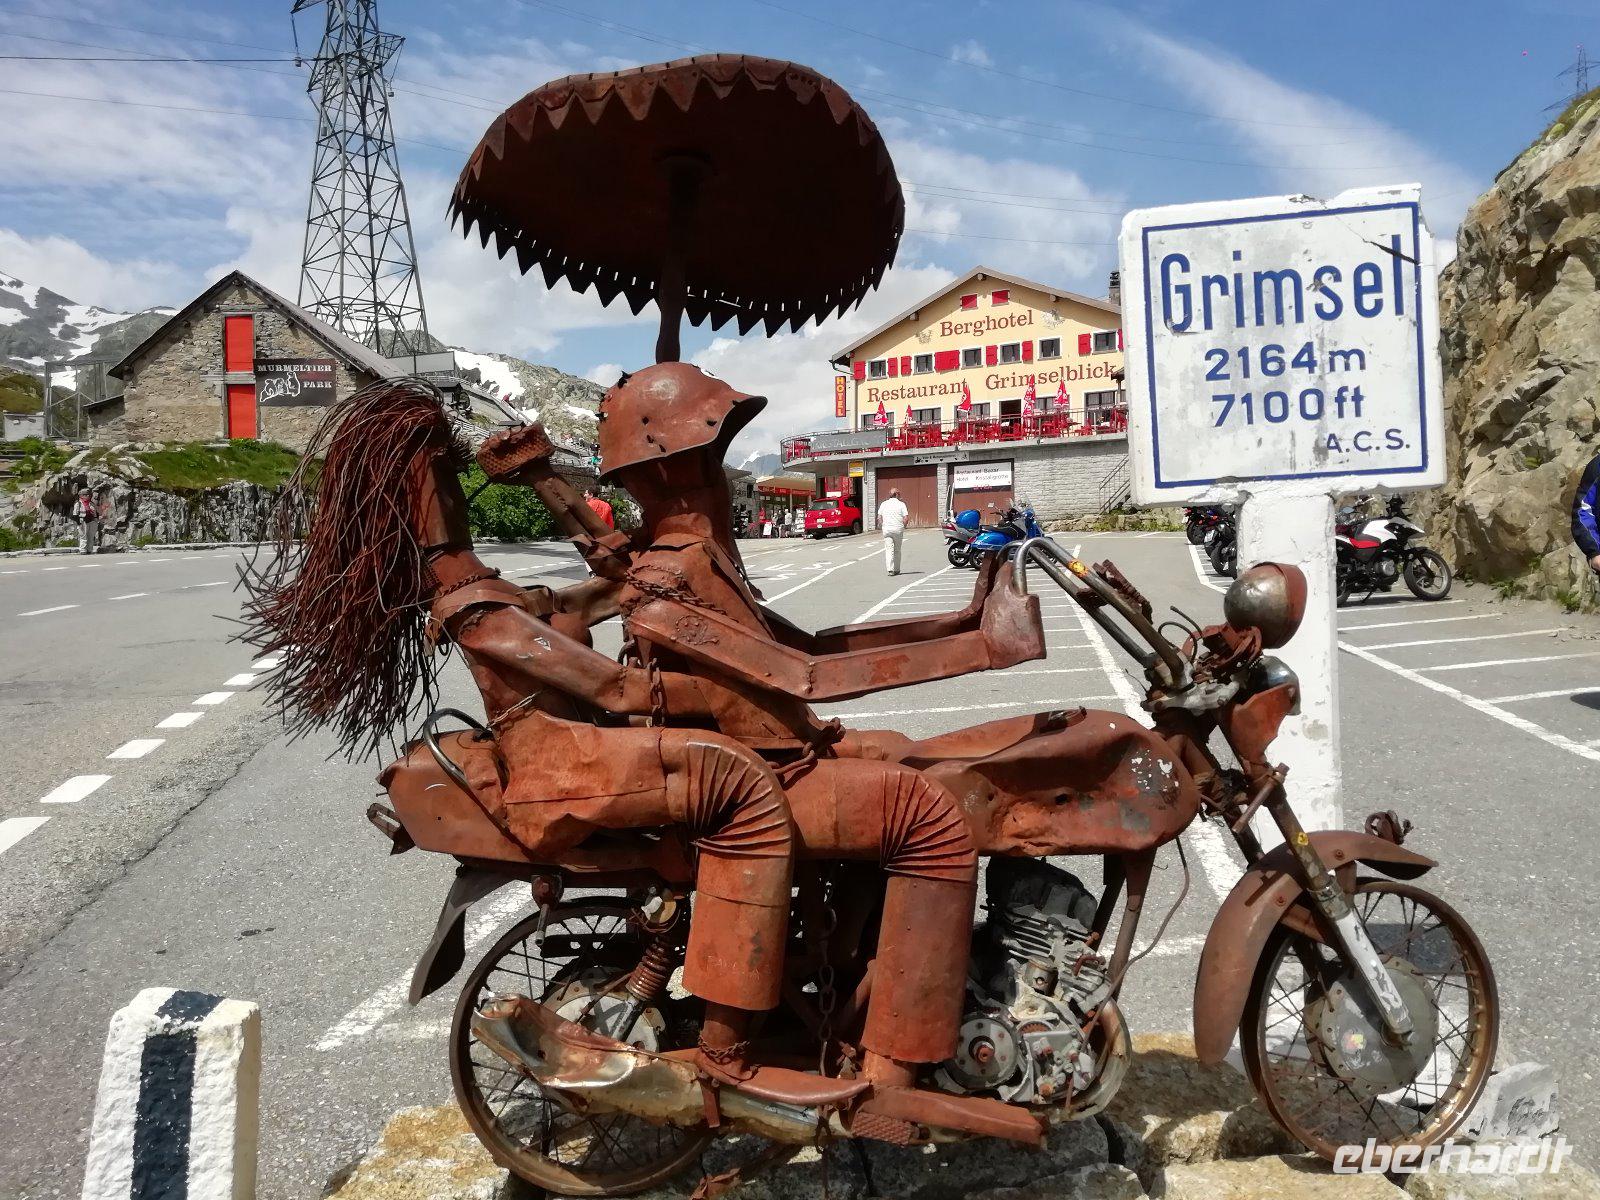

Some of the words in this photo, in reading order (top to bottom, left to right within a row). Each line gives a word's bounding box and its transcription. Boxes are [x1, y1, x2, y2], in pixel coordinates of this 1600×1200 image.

[1160, 233, 1406, 333] Grimsel
[940, 309, 1034, 338] Berghotel
[836, 377, 846, 417] HOTEL
[867, 378, 968, 403] Restaurant
[985, 361, 1117, 391] Grimselblick
[1326, 427, 1411, 454] A.C.S.
